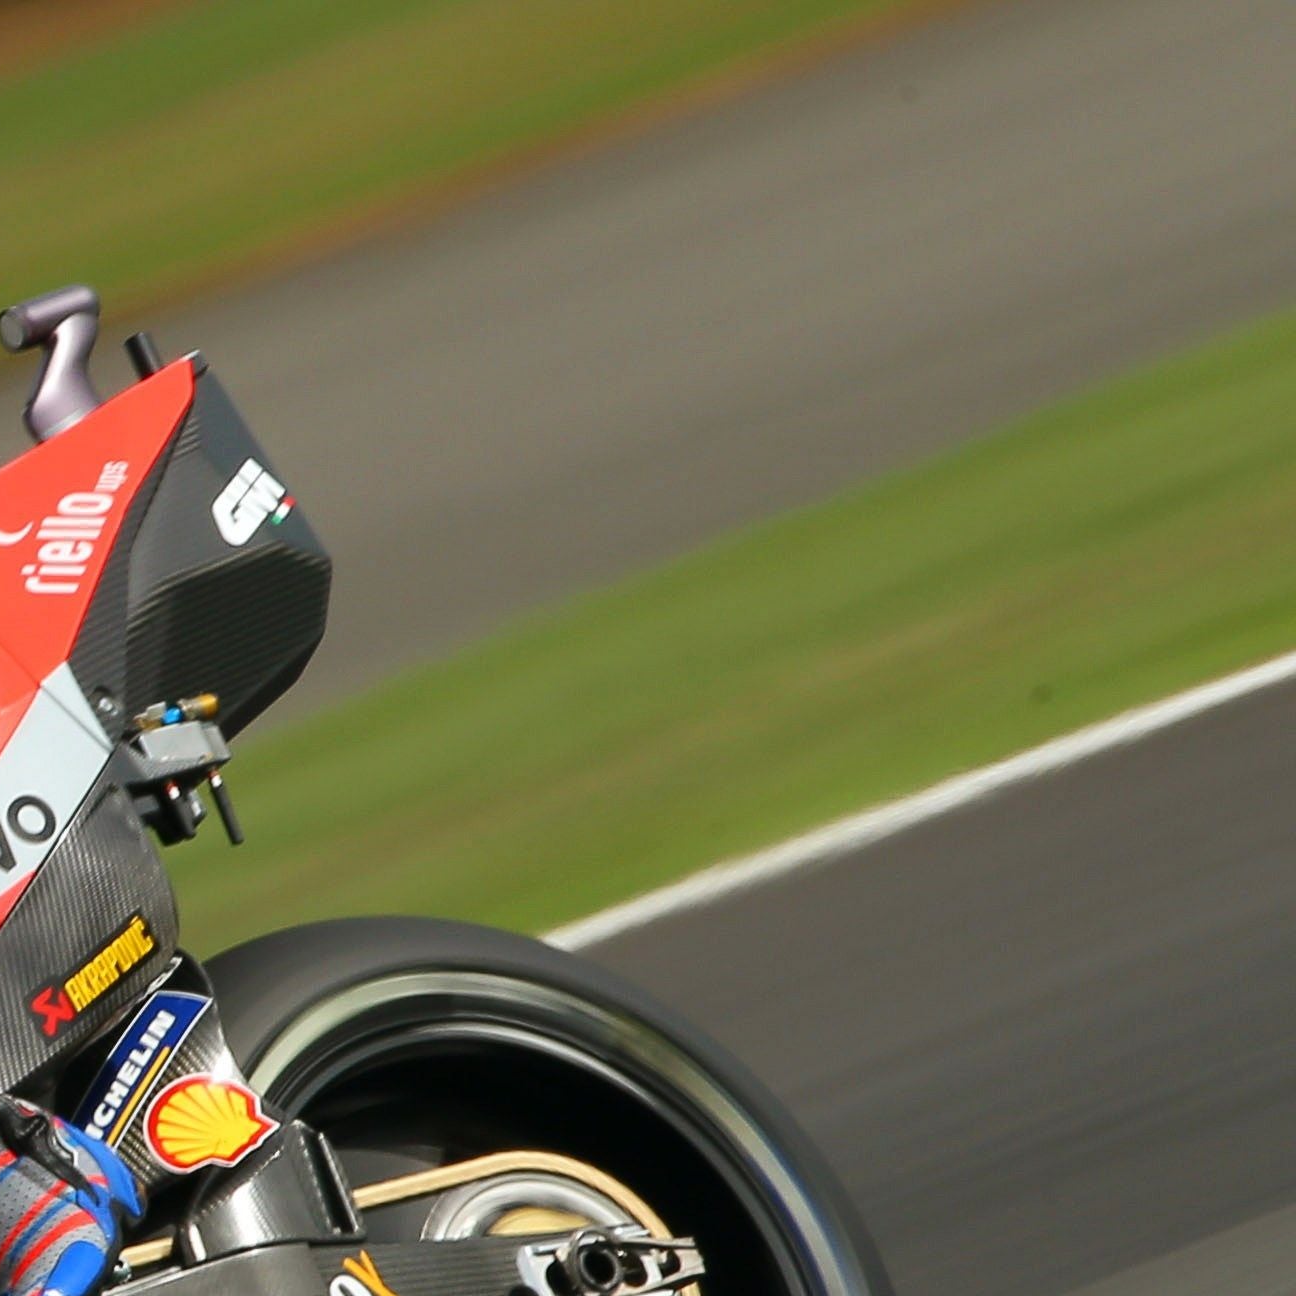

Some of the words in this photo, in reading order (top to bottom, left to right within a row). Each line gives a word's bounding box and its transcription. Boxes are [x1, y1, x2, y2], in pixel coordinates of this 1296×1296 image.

[20, 491, 114, 594] riello
[95, 460, 129, 492] ups
[84, 1009, 177, 1141] ICHELIN
